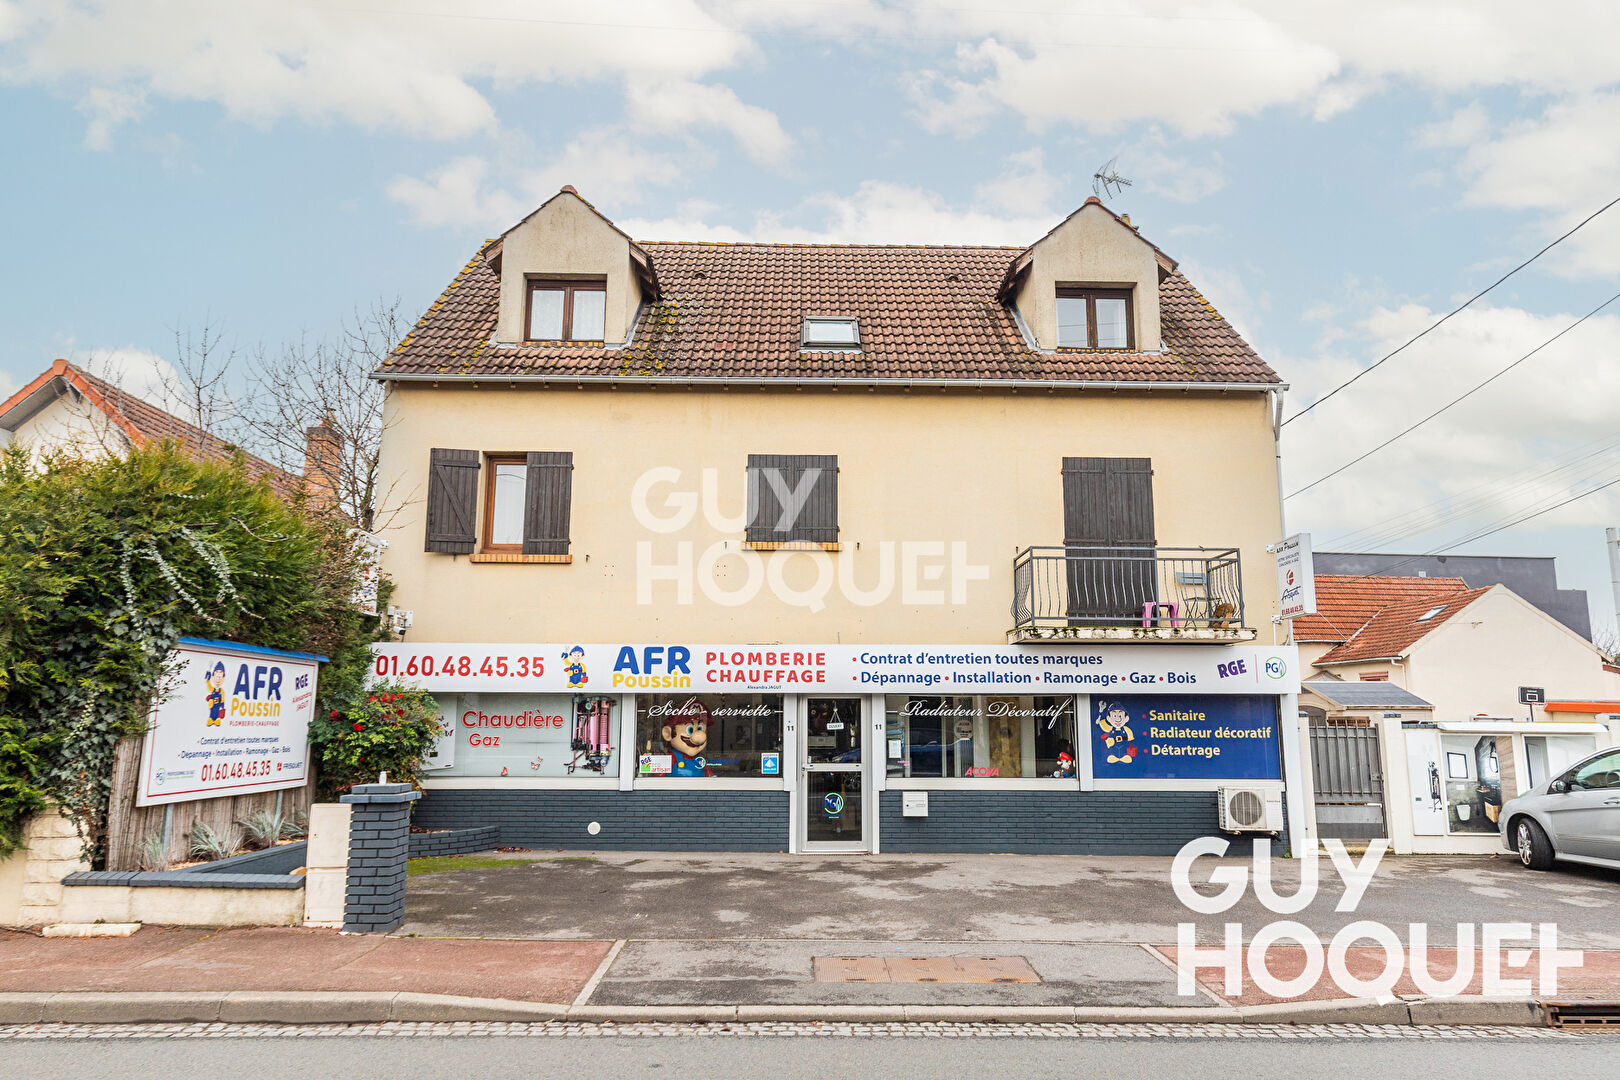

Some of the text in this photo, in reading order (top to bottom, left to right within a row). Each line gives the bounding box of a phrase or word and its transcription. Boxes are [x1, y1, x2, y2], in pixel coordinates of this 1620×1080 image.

[375, 655, 545, 678] 01.60.48.45.35
[613, 646, 691, 675] AFR
[705, 652, 826, 666] PLOMBERIE
[860, 652, 913, 665] Contrat
[995, 653, 1039, 665] toutes
[1042, 654, 1103, 668] marques
[706, 669, 826, 683] CHAUFFAGE
[1217, 659, 1247, 679] RGE
[233, 664, 282, 700] AFR
[295, 674, 308, 690] RGE
[612, 672, 691, 688] Poussin
[861, 671, 1197, 686] Dépannage Installation Ramonage Gaz Bois
[230, 697, 280, 717] Poussin
[711, 704, 772, 717] serviette
[899, 696, 1072, 730] Radiateur Décoratif
[462, 710, 564, 728] Chaudière
[1149, 710, 1206, 721] Sanitaire
[469, 733, 500, 747] Gaz
[1150, 726, 1272, 739] Radiateur décoratif
[215, 748, 242, 756] Installation
[245, 747, 269, 756] Ramonage
[1151, 744, 1221, 758] Détartrage
[201, 760, 271, 782] 01.60.48.45.35
[964, 766, 1000, 777] ACOVA
